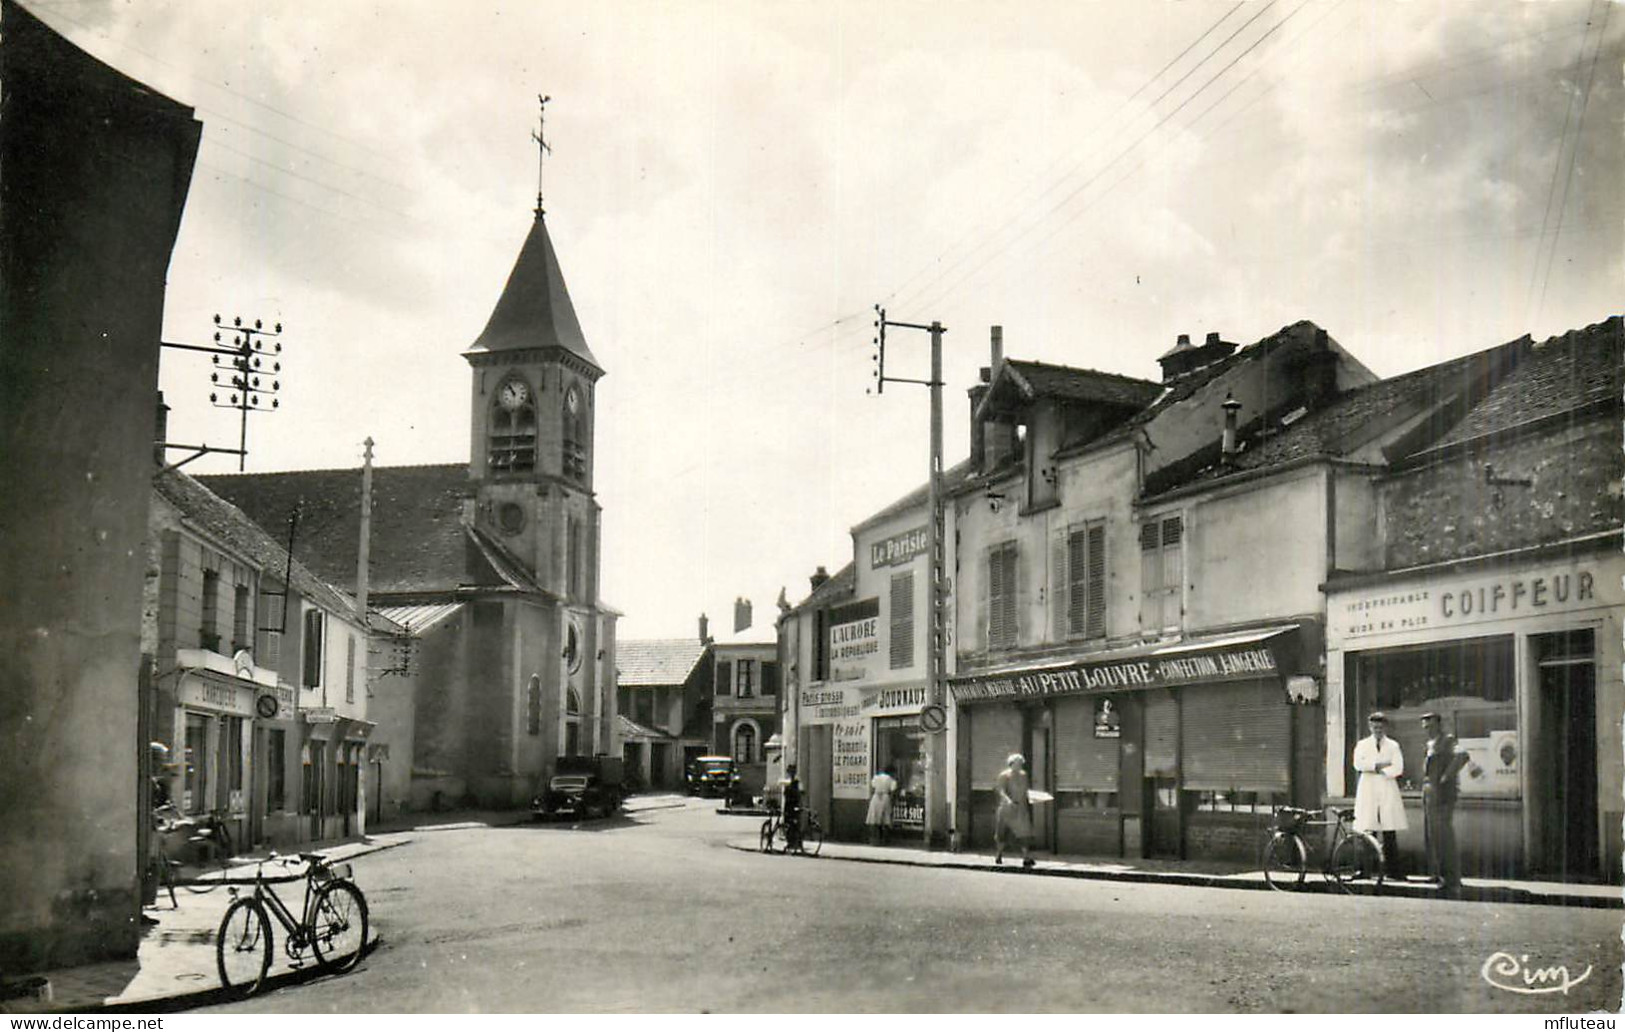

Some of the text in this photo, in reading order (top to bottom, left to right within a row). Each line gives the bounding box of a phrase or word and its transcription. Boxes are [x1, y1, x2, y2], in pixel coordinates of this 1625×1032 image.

[873, 545, 884, 564] Le
[1441, 571, 1595, 618] COIFFEUR
[833, 619, 877, 644] L'AURORE
[1019, 676, 1041, 695] AU
[1038, 670, 1082, 694] PETIT
[1081, 661, 1155, 690] LOUVRE
[1218, 648, 1277, 676] LINGERIE
[879, 687, 926, 709] JOURNAUX
[834, 755, 868, 767] LE FIGARO
